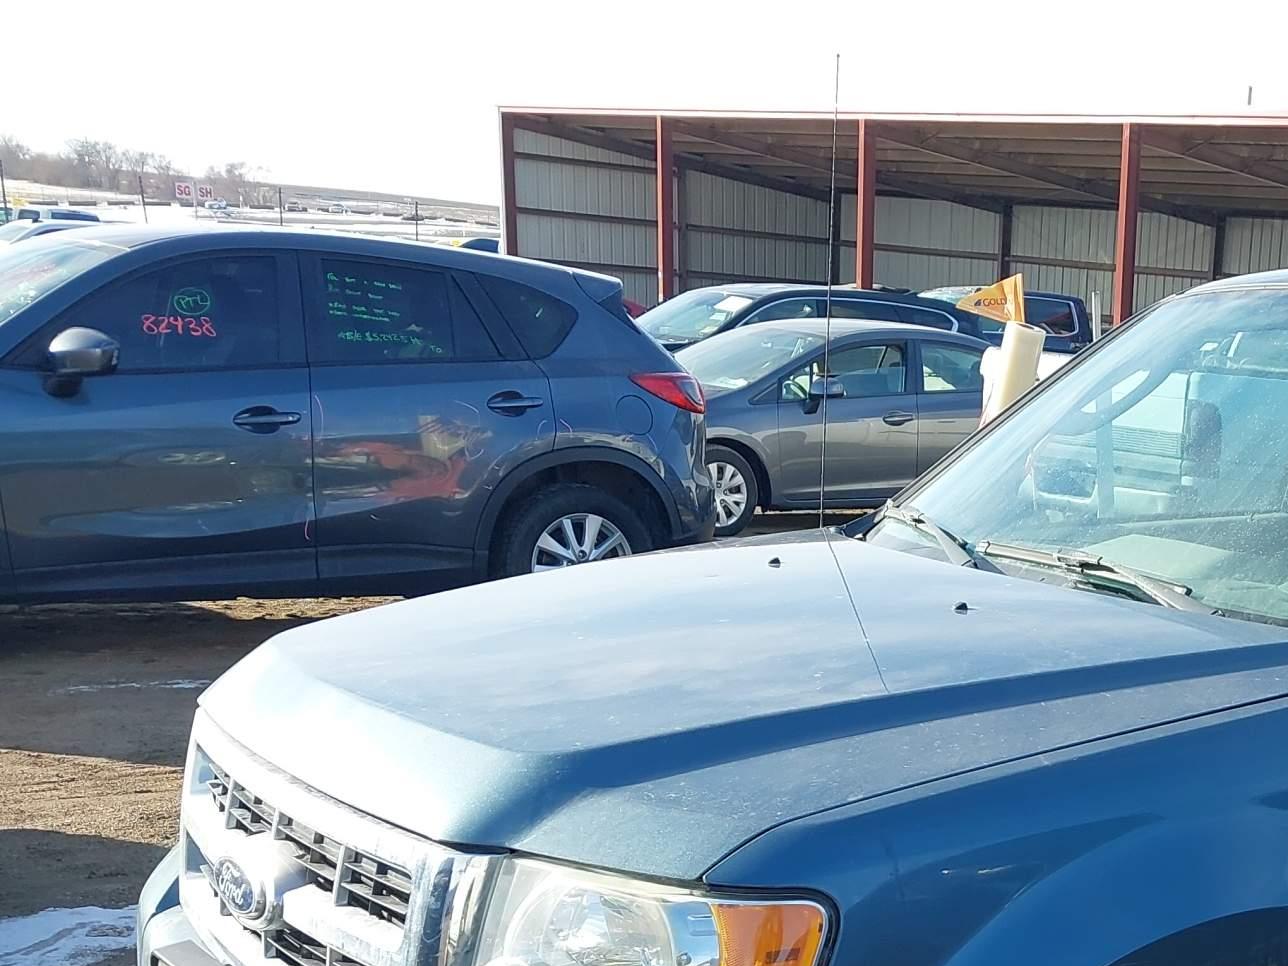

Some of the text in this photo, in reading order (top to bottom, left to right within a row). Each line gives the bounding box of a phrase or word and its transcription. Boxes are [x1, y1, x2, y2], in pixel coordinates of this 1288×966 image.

[176, 185, 191, 197] SG
[198, 186, 213, 198] SH
[142, 314, 217, 336] 82438
[218, 861, 246, 905] Ford
